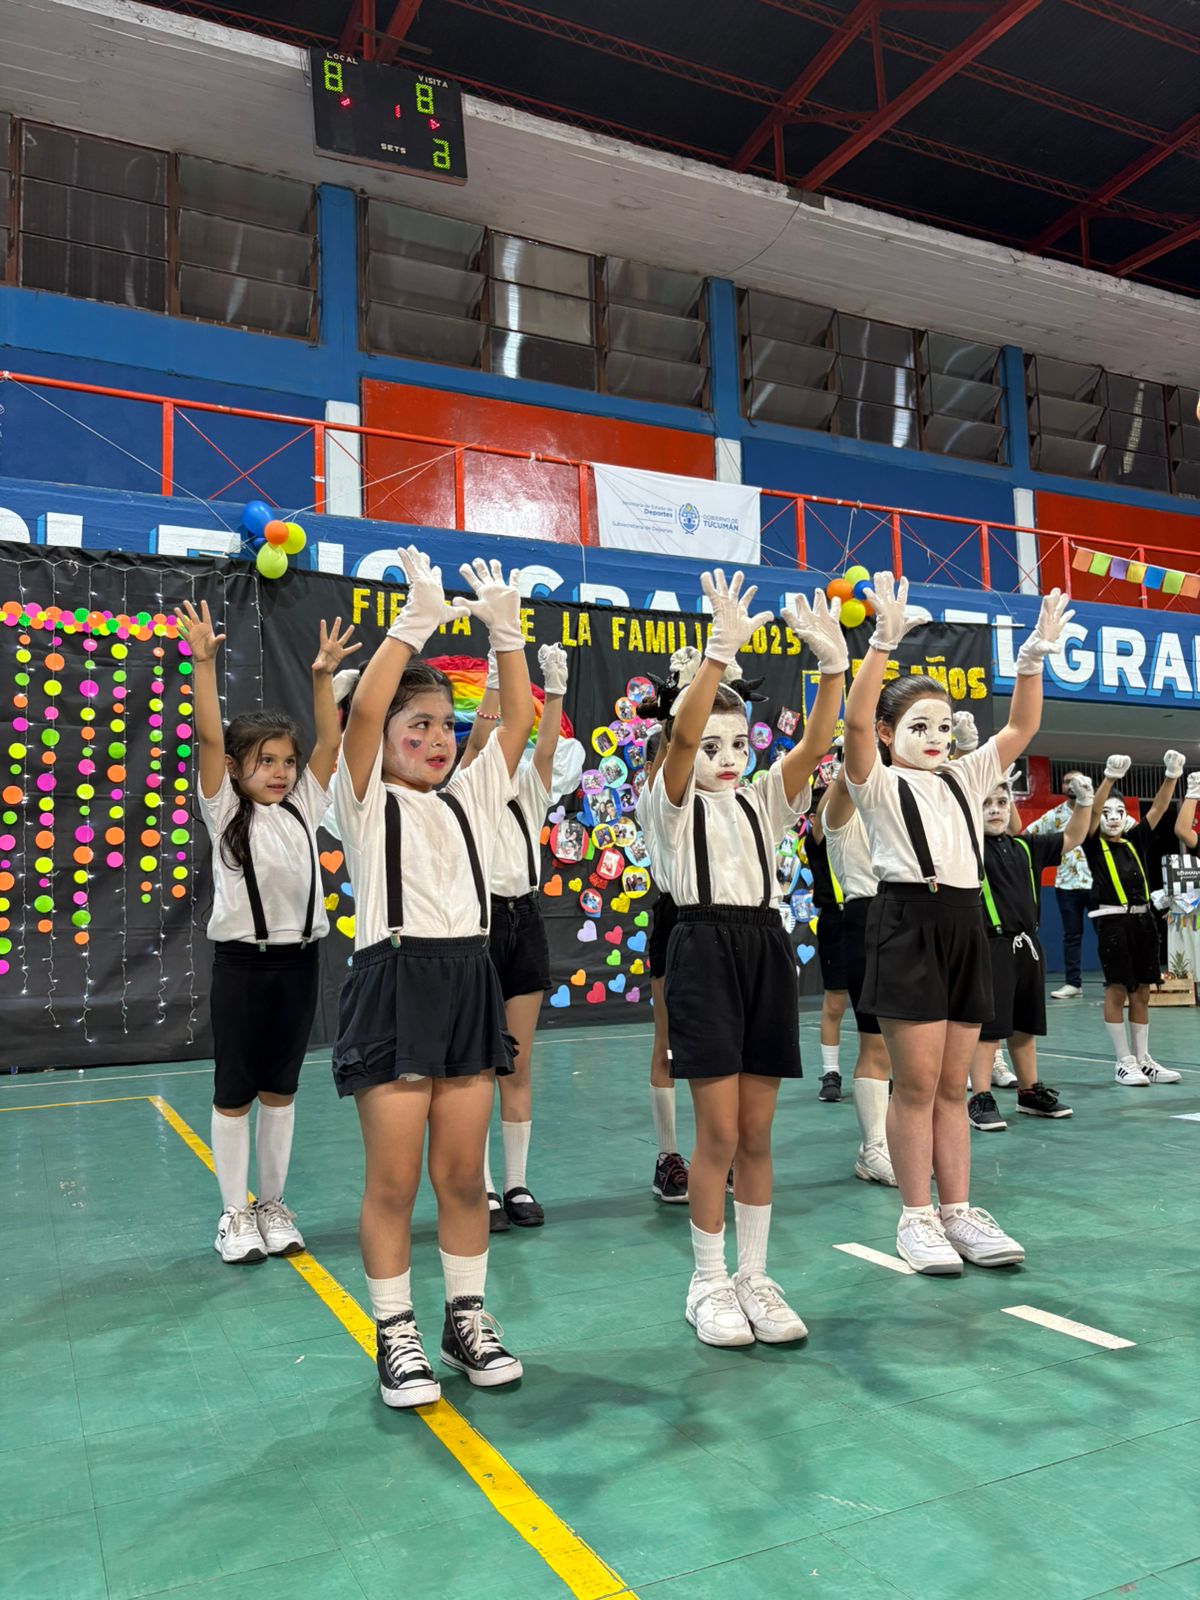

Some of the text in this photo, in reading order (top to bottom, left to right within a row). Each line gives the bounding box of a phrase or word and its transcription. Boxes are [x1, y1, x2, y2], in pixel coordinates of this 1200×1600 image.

[326, 51, 358, 65] LOCAL
[323, 59, 343, 93] 8
[417, 74, 449, 89] VISITA
[415, 82, 434, 115] 8
[380, 142, 406, 155] SETS
[644, 508, 673, 518] Deportes
[702, 514, 730, 523] GOBIERNO
[352, 588, 471, 636] FIEA
[562, 611, 592, 647] LA
[611, 616, 713, 654] FAMILI
